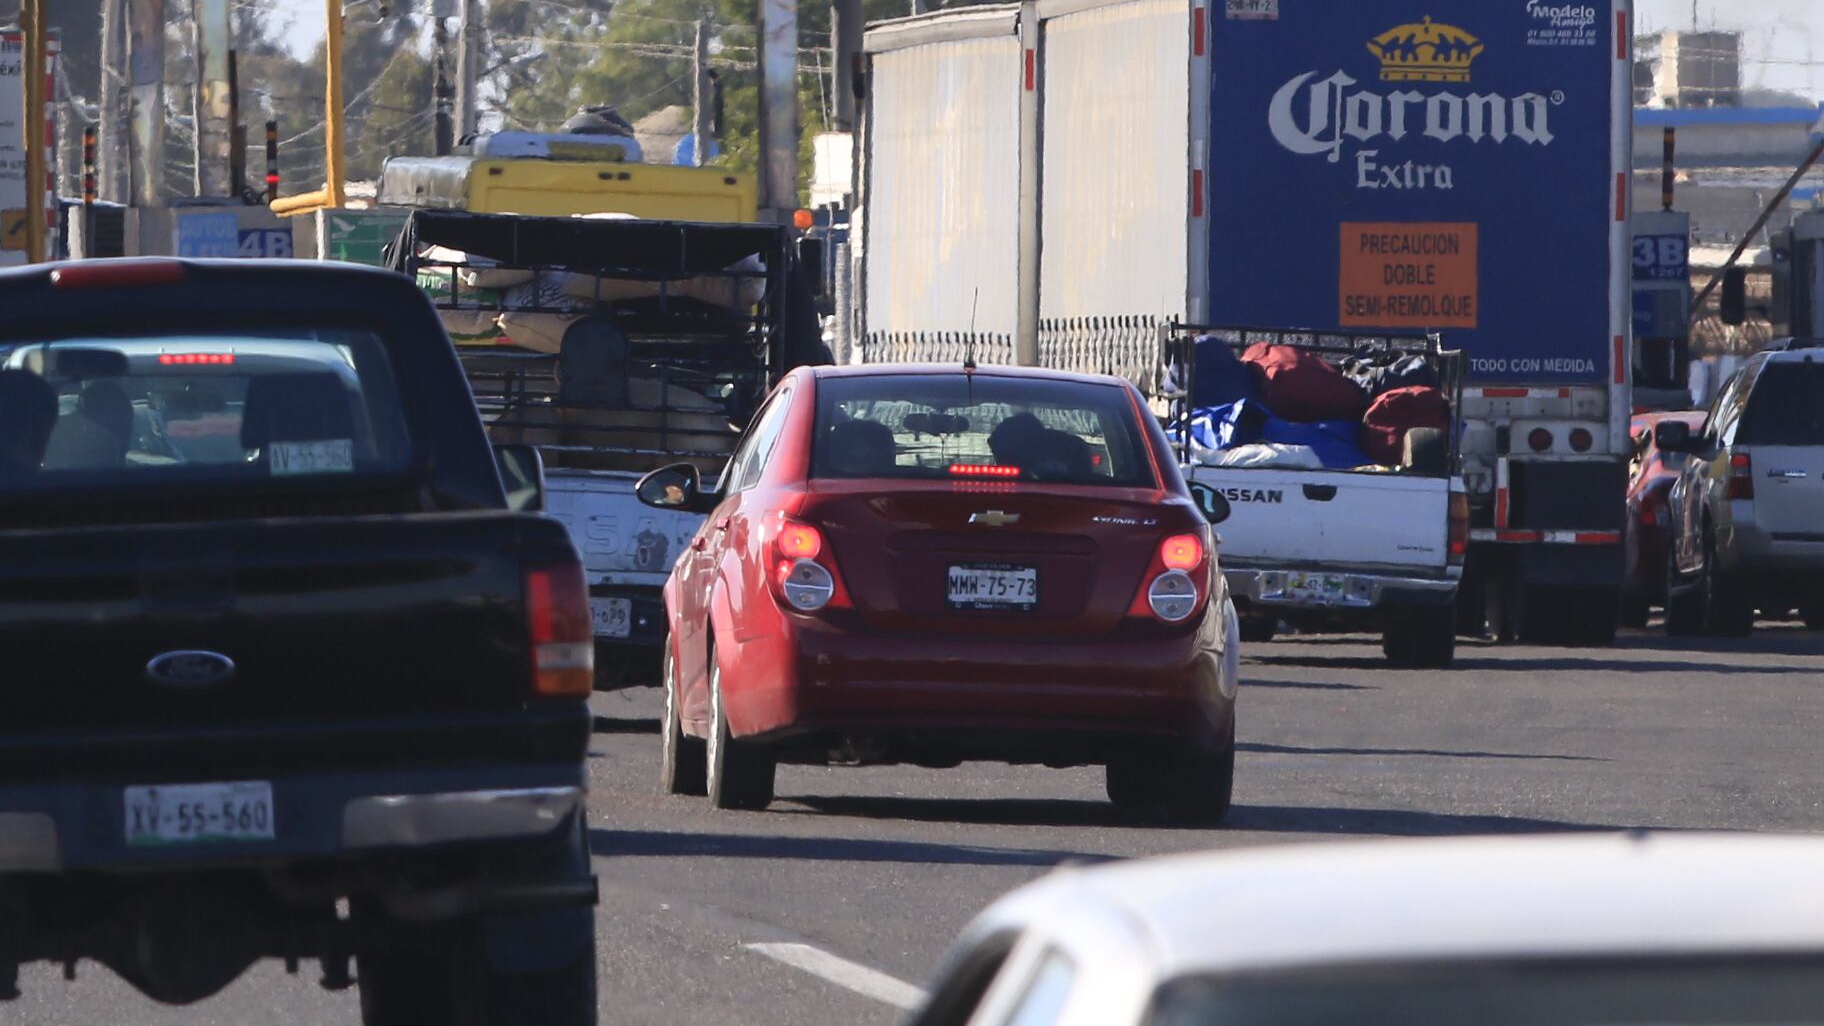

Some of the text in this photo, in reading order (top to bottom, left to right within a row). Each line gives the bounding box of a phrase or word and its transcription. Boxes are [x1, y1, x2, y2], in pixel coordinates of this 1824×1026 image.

[1532, 4, 1596, 18] Modelo
[1268, 69, 1555, 163] Corona
[1356, 149, 1454, 190] Extra
[239, 231, 292, 258] 4B
[1359, 233, 1459, 255] PRECAUCION
[1632, 236, 1685, 267] 3B
[1383, 264, 1436, 286] DOBLE
[1344, 294, 1473, 318] SEMI-REMOLQUE
[1471, 358, 1595, 372] TODO CON MEDIDA
